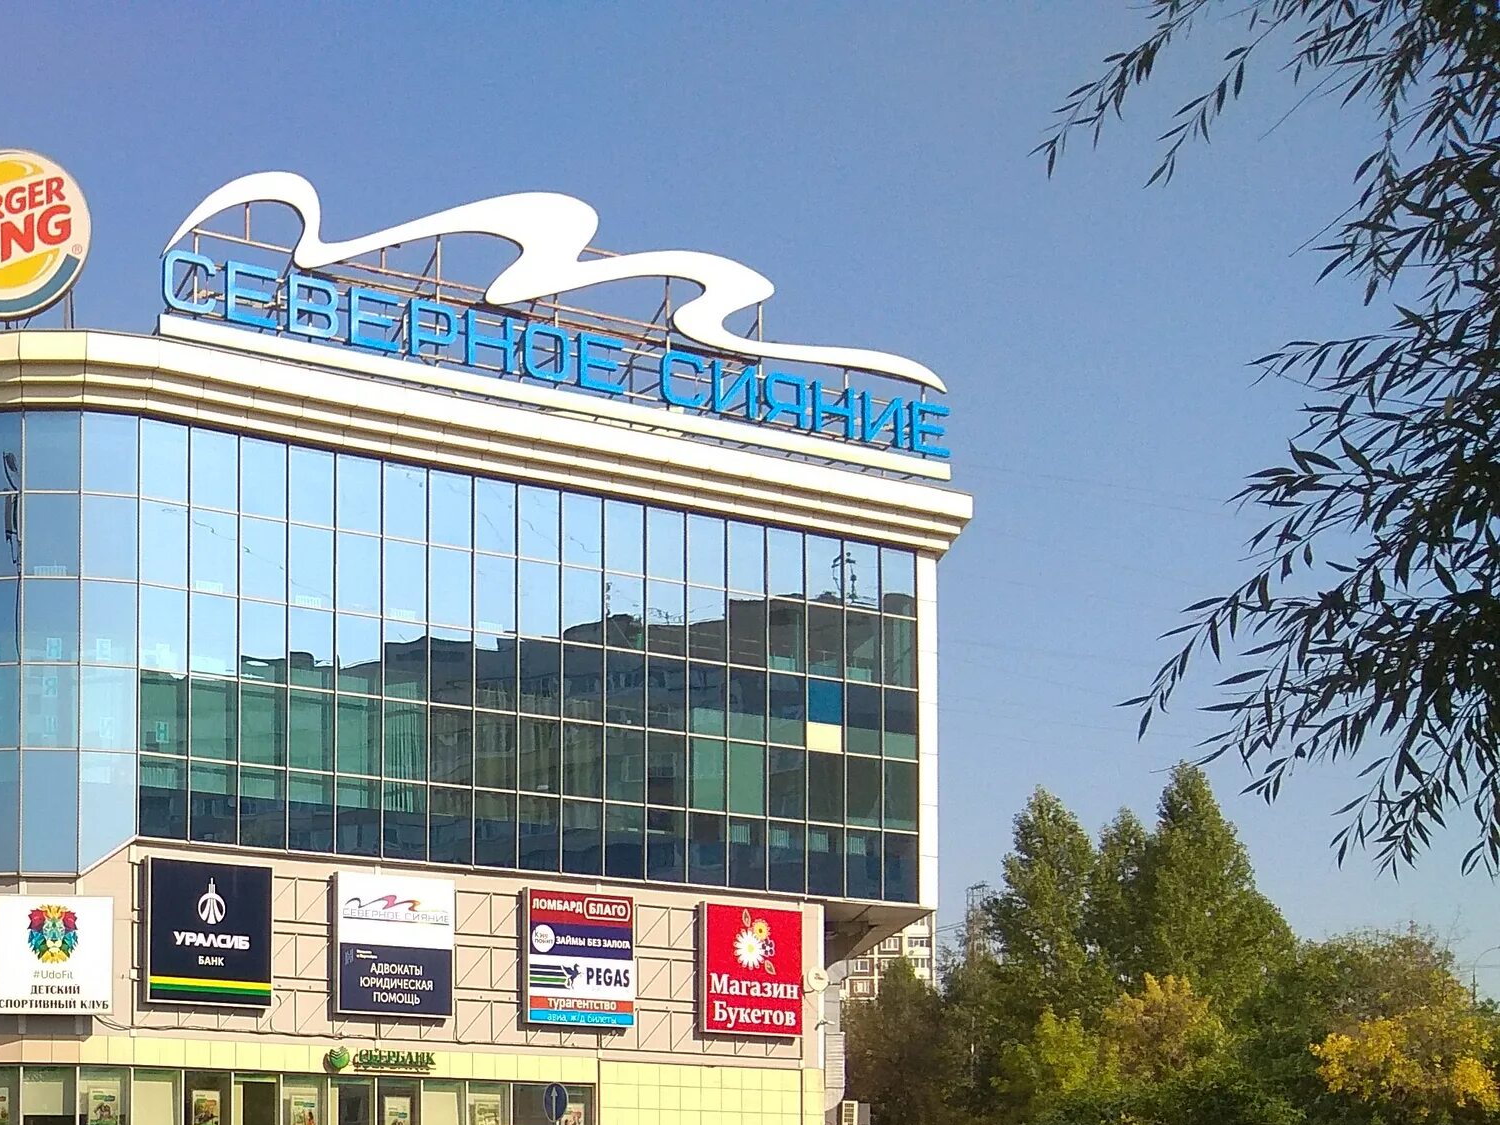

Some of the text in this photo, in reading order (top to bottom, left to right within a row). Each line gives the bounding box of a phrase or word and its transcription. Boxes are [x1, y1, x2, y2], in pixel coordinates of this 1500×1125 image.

[162, 249, 951, 458] СЕВЕРНОЕ СИЯНИЕ
[342, 907, 449, 923] СЕВЕРНОЕ СИЯНИЕ
[532, 898, 626, 917] ЛОМБАРД БЛАГО
[173, 930, 250, 950] УРАЛСИБ
[555, 935, 631, 950] ЗАЙМЫ БЕЗ ЗАЛОГА
[198, 955, 225, 967] БАНК
[33, 970, 74, 980] #UdoFit
[370, 962, 423, 977] АДВОКАТЫ
[359, 976, 434, 991] ЮРИДИЧЕСКАЯ
[586, 967, 630, 988] PEGAS
[30, 983, 81, 995] ДЕТСКИЙ
[709, 972, 800, 1000] Магазин
[80, 1000, 109, 1010] КЛУБ
[373, 991, 421, 1006] ПОМОЩЬ
[547, 997, 617, 1011] турагентство
[587, 1014, 617, 1024] билеты
[713, 1000, 797, 1029] Букетов
